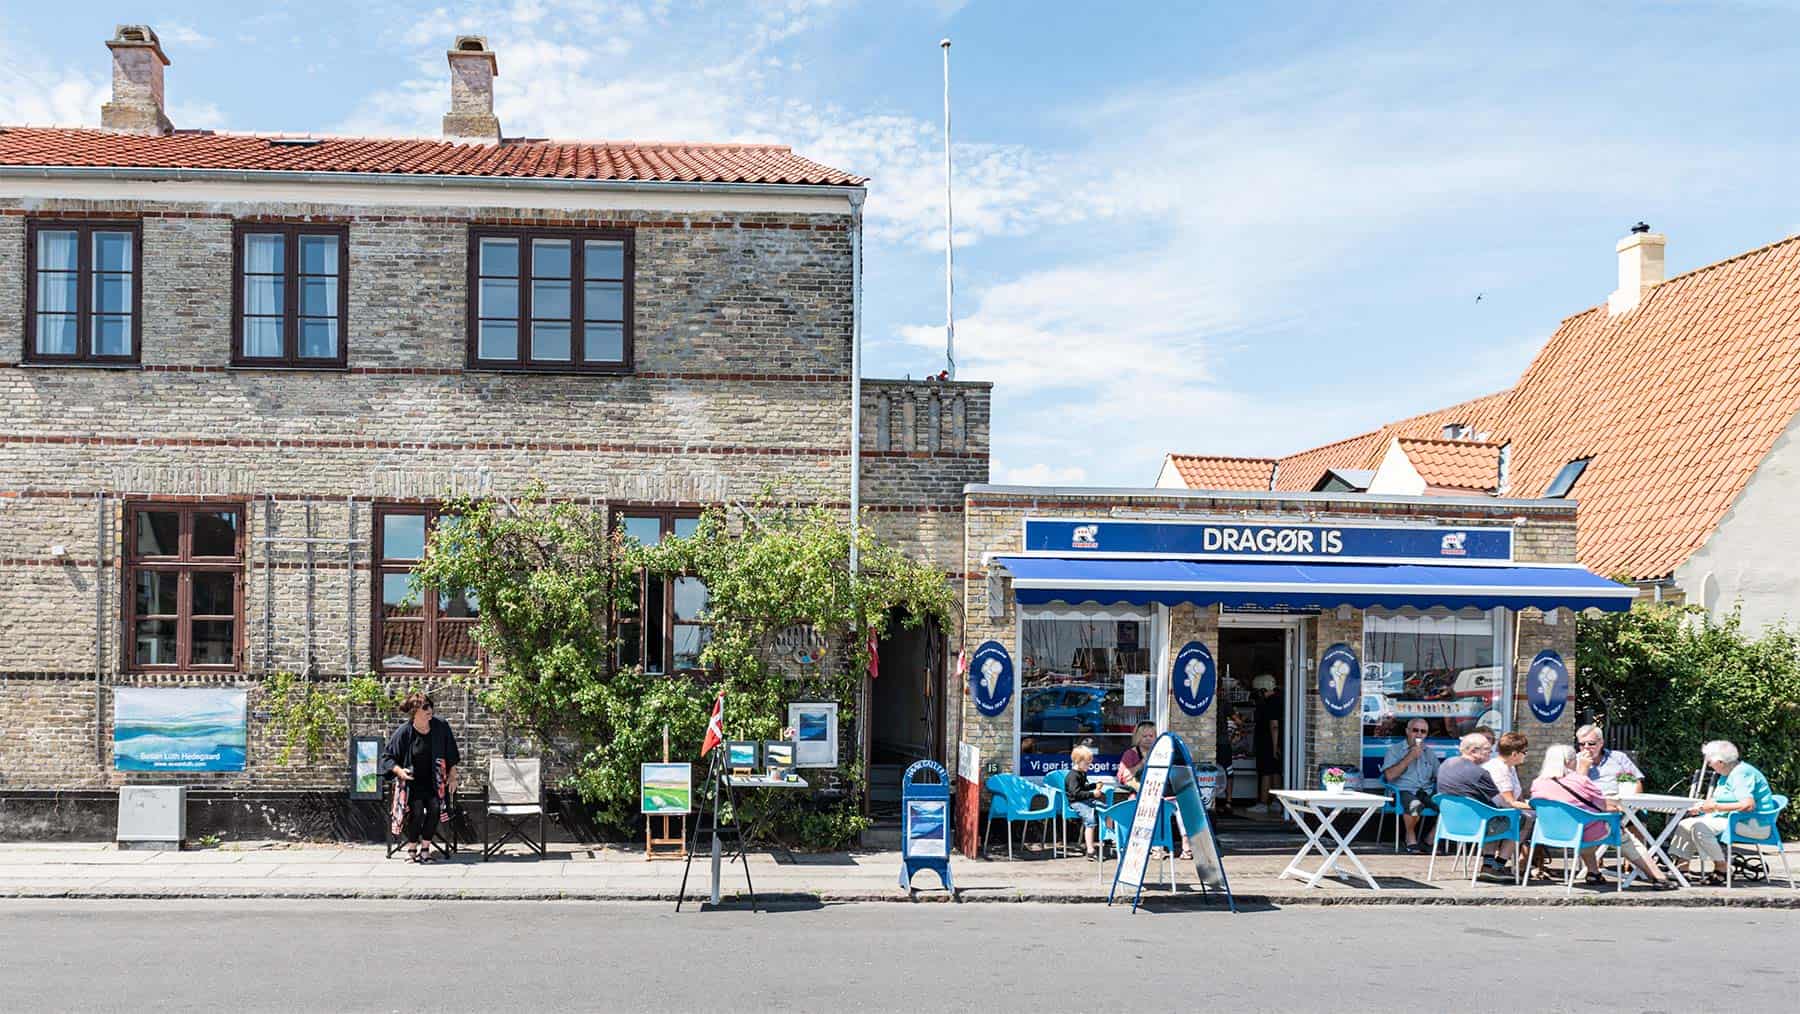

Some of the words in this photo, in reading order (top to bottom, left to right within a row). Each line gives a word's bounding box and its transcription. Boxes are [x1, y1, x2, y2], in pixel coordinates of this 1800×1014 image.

[1203, 527, 1313, 553] DRAGØR
[1320, 530, 1343, 554] IS
[181, 751, 220, 762] Hedegaard
[1030, 760, 1040, 771] Vi
[1061, 760, 1069, 771] is
[1088, 762, 1110, 773] oget
